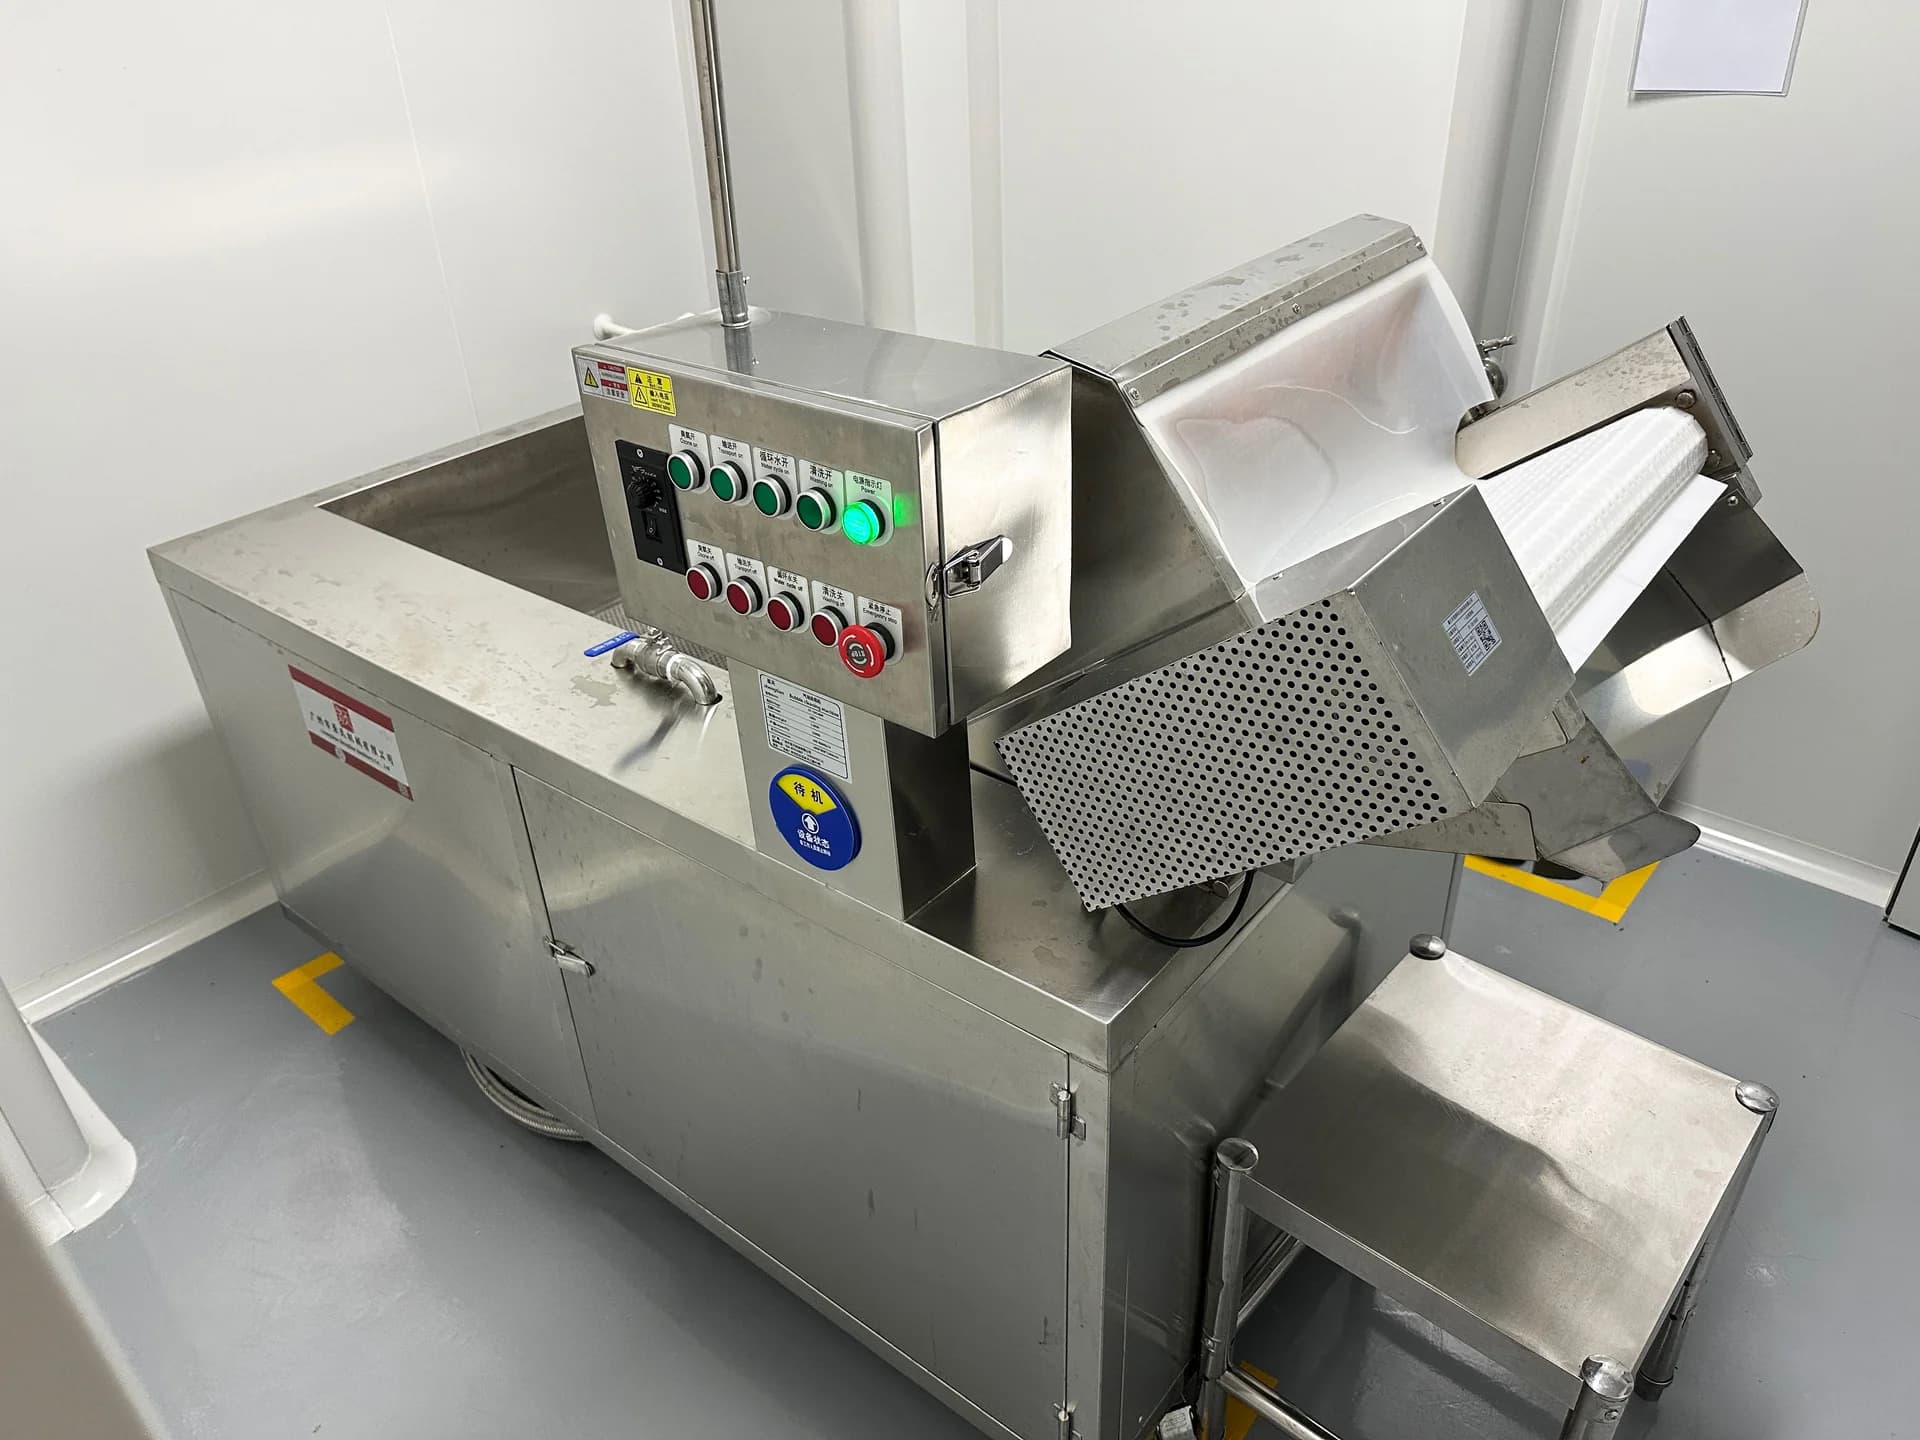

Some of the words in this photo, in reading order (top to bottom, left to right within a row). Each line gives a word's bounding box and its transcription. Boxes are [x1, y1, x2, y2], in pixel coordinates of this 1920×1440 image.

[760, 450, 789, 467] 循环水开
[810, 465, 832, 481] 清洗开
[853, 475, 883, 490] 电源指示灯
[861, 486, 876, 495] Power
[823, 586, 844, 600] 清洗关
[862, 607, 886, 622] Emergency
[868, 601, 892, 616] 紧急停止
[850, 649, 866, 659] STOP
[793, 781, 824, 805] 待机
[797, 829, 830, 849] 设备状态
